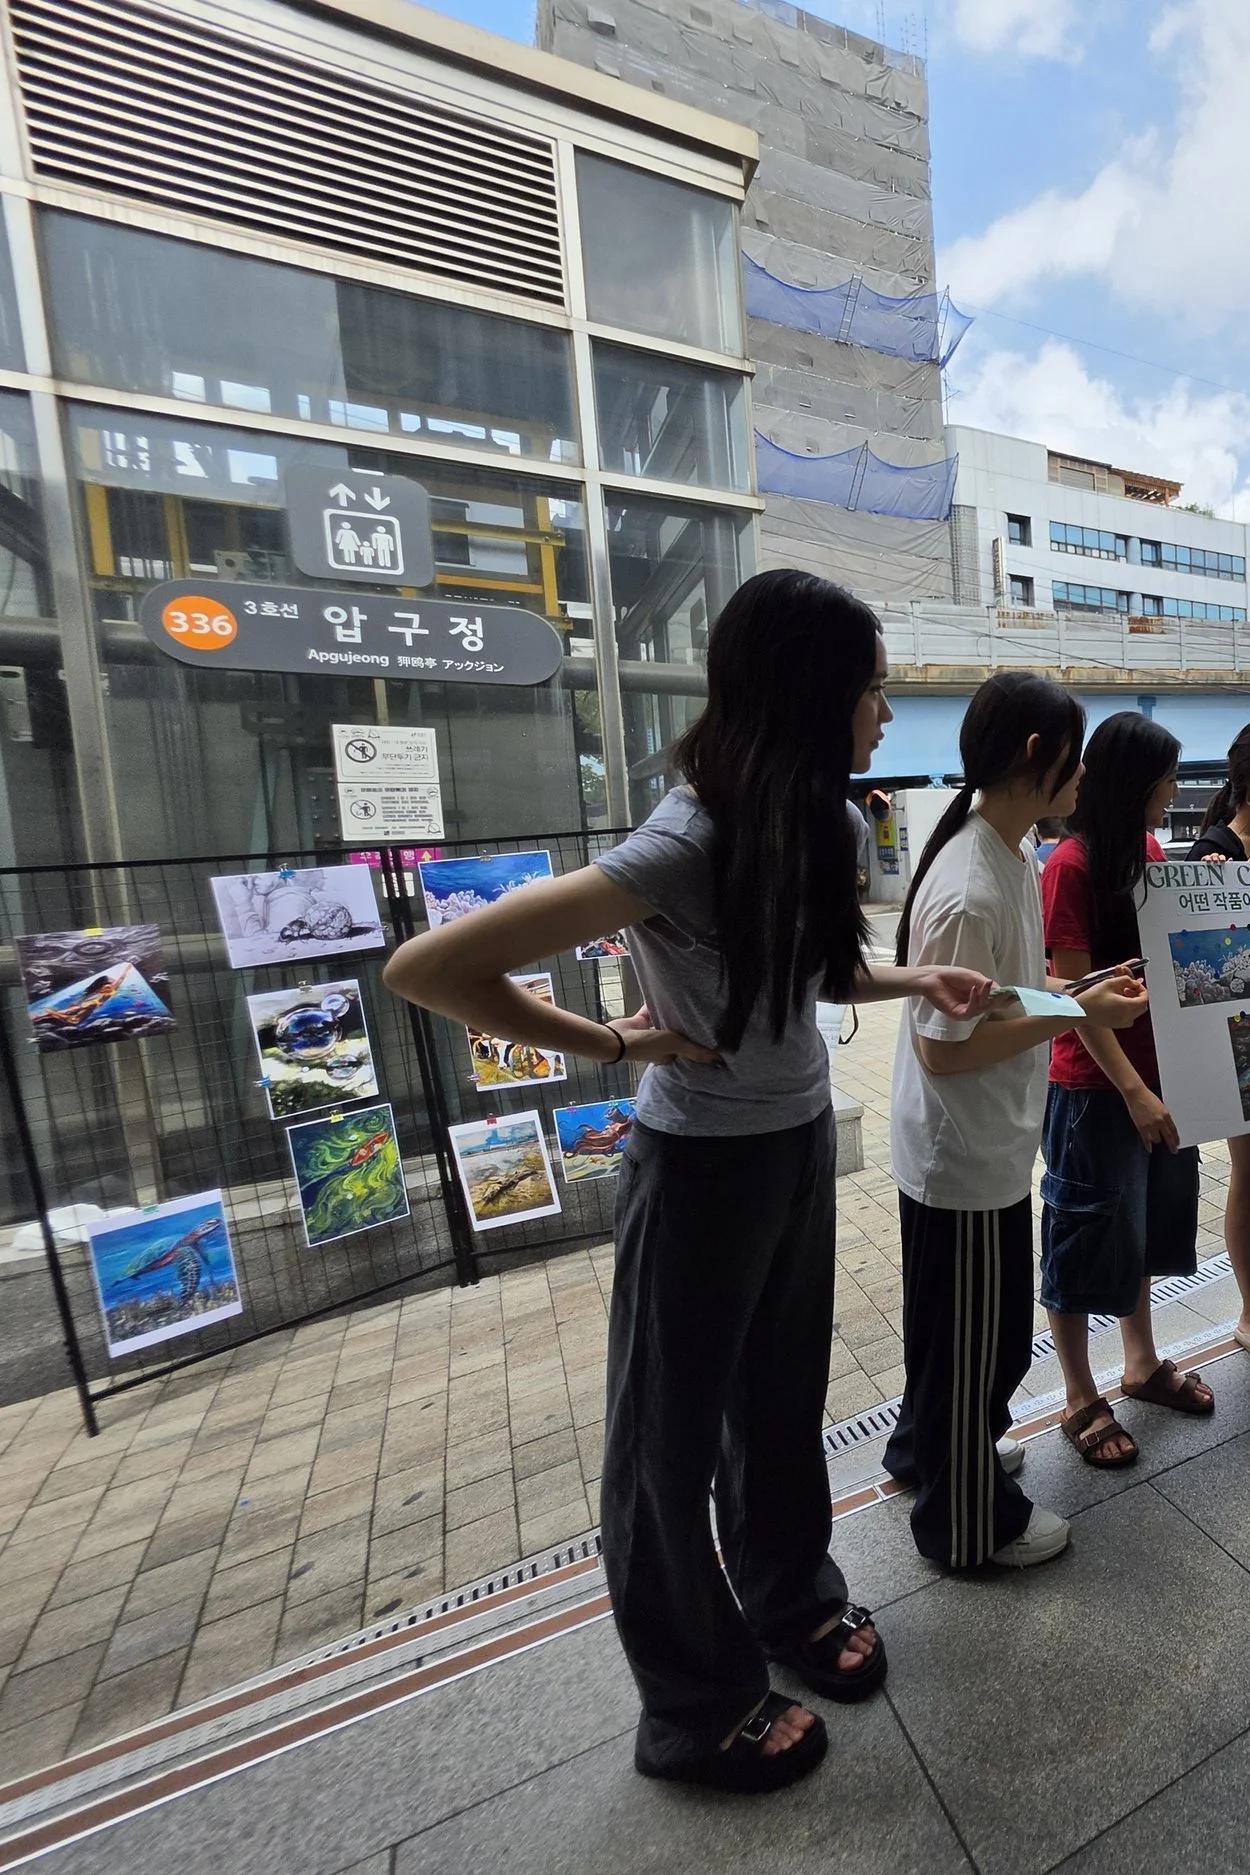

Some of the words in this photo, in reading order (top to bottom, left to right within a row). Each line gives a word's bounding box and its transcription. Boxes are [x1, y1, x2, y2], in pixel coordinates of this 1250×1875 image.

[244, 600, 299, 619] 3호선
[168, 611, 233, 637] 336
[307, 648, 390, 667] Apgujeong
[442, 659, 504, 672] アックジョン
[1147, 865, 1226, 889] GREEN
[1179, 892, 1210, 912] 어떤
